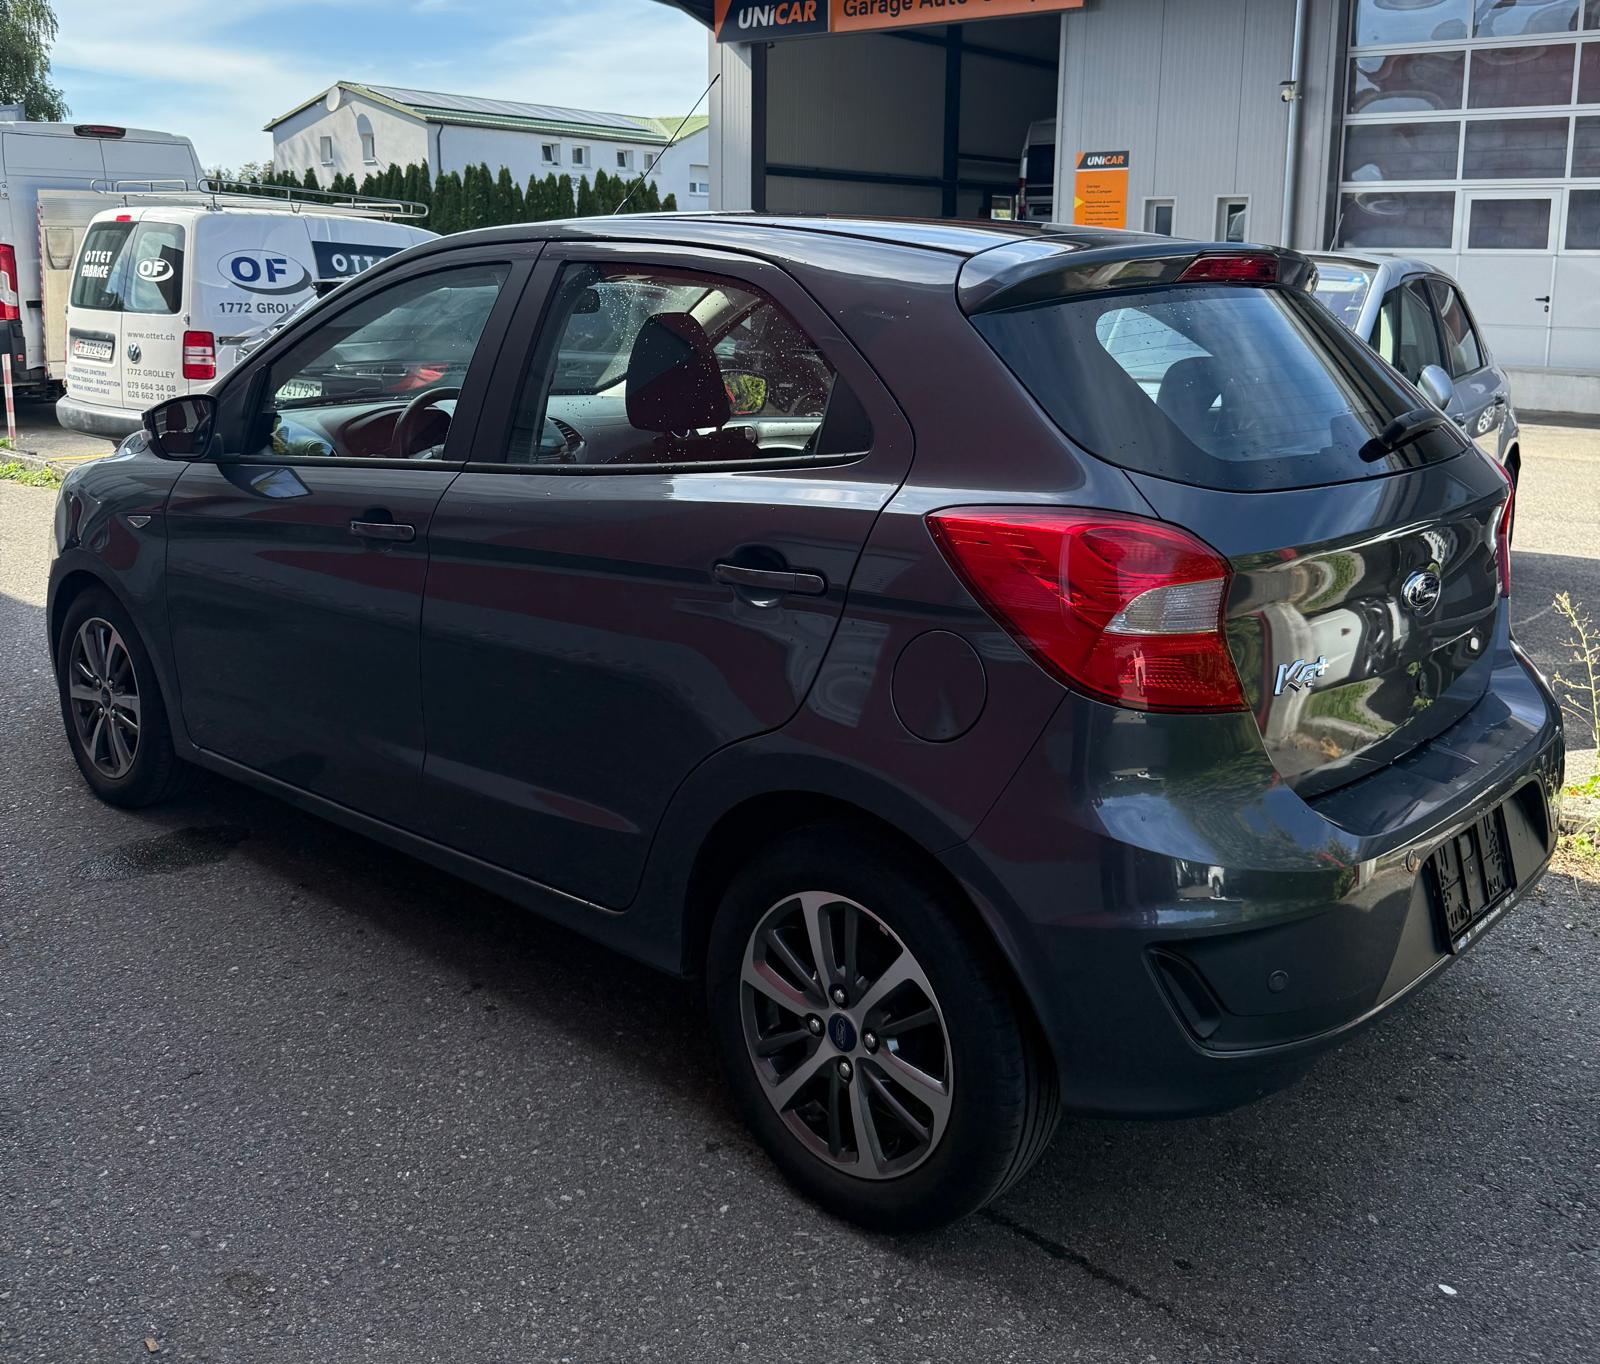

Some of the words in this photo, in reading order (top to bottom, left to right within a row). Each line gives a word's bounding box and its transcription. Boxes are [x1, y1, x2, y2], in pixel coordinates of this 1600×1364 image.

[843, 0, 913, 18] Garage
[84, 250, 112, 263] OTTET
[139, 260, 165, 277] OF
[331, 253, 385, 273] OTT
[231, 256, 288, 283] OF
[219, 302, 252, 314] 1772
[127, 331, 175, 341] www.ottet.ch
[127, 367, 142, 376] 1772
[143, 369, 175, 379] GROLLEY
[127, 381, 139, 390] 079
[140, 382, 152, 390] 664
[155, 383, 164, 391] 34
[166, 384, 176, 392] 08
[127, 390, 140, 399] 026
[141, 391, 154, 400] 662
[156, 392, 165, 401] 10
